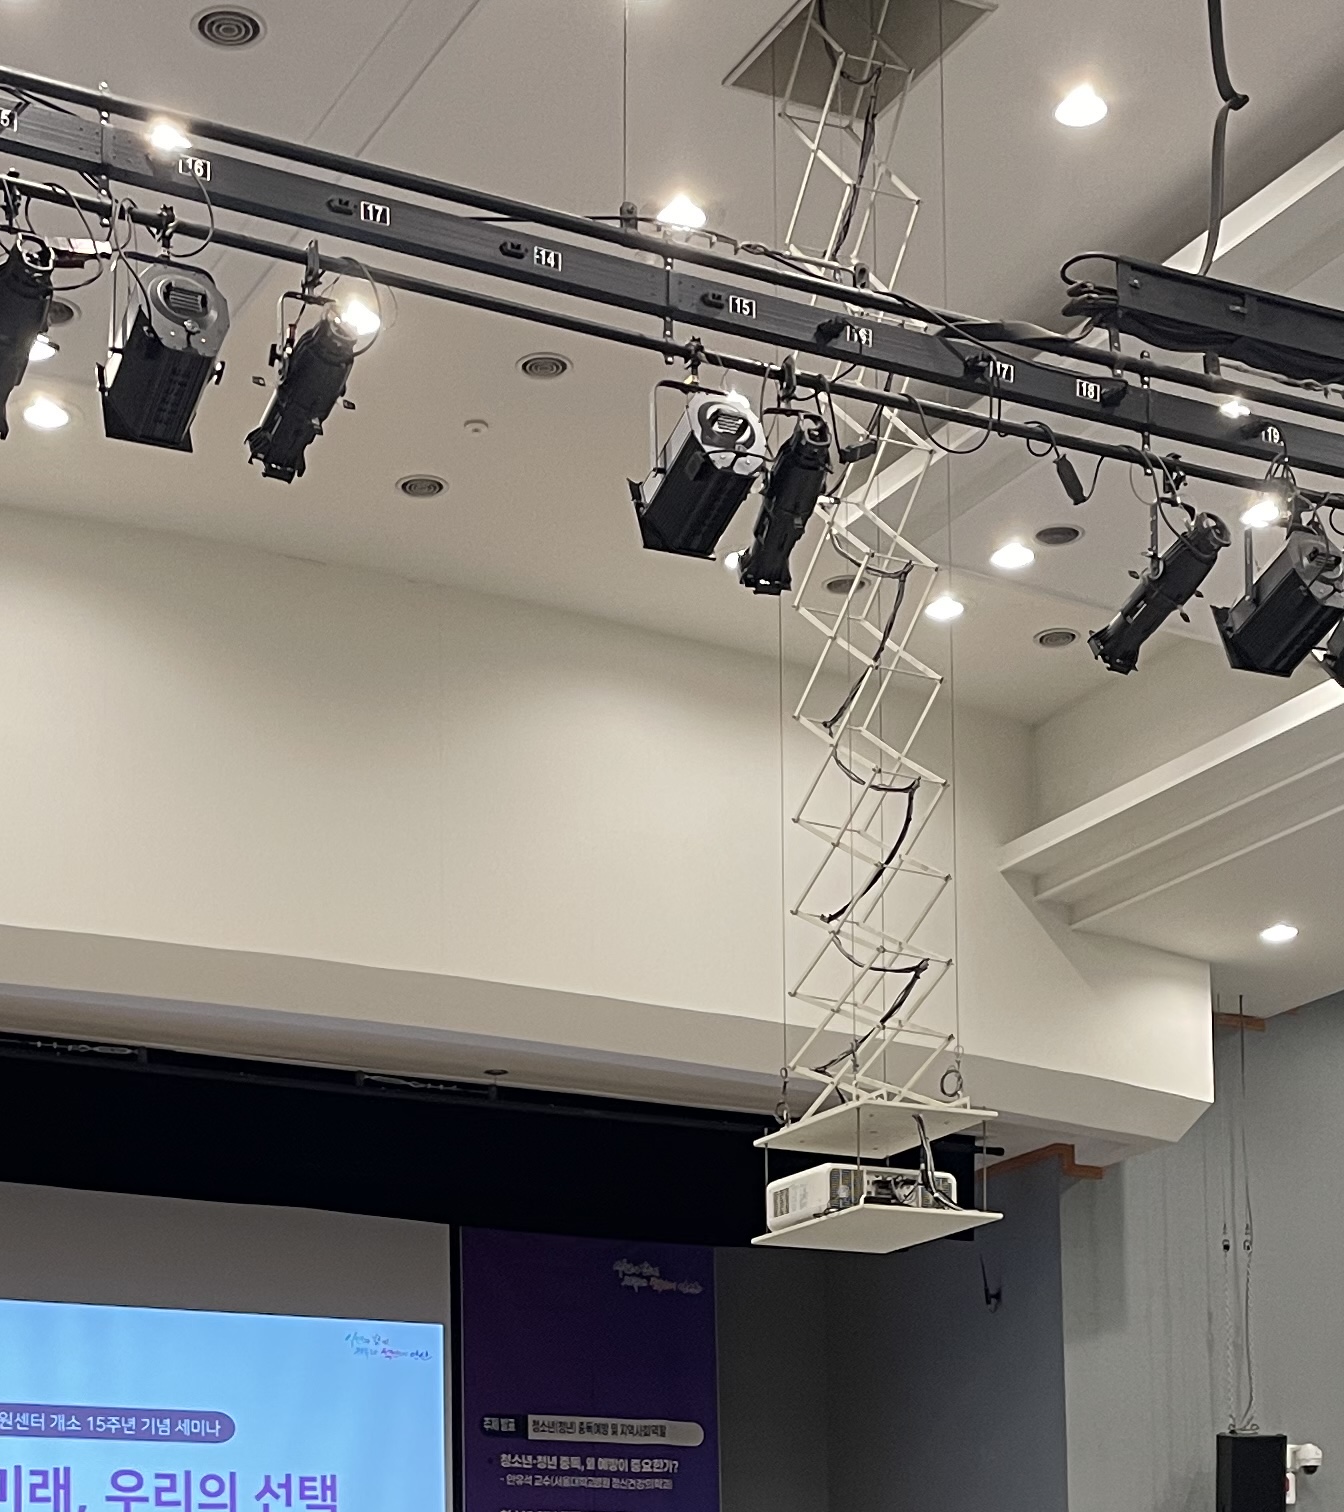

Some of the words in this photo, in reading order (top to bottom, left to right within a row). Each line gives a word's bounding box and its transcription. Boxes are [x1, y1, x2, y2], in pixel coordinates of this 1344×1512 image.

[185, 156, 204, 177] 16
[366, 203, 384, 223] 17
[540, 249, 556, 268] 14
[734, 296, 751, 316] 15
[1081, 379, 1095, 398] 18
[1267, 426, 1280, 444] 19
[50, 1413, 83, 1433] 개소
[87, 1414, 137, 1435] 15주년
[141, 1416, 172, 1437] 기념
[175, 1417, 222, 1438] 세미나
